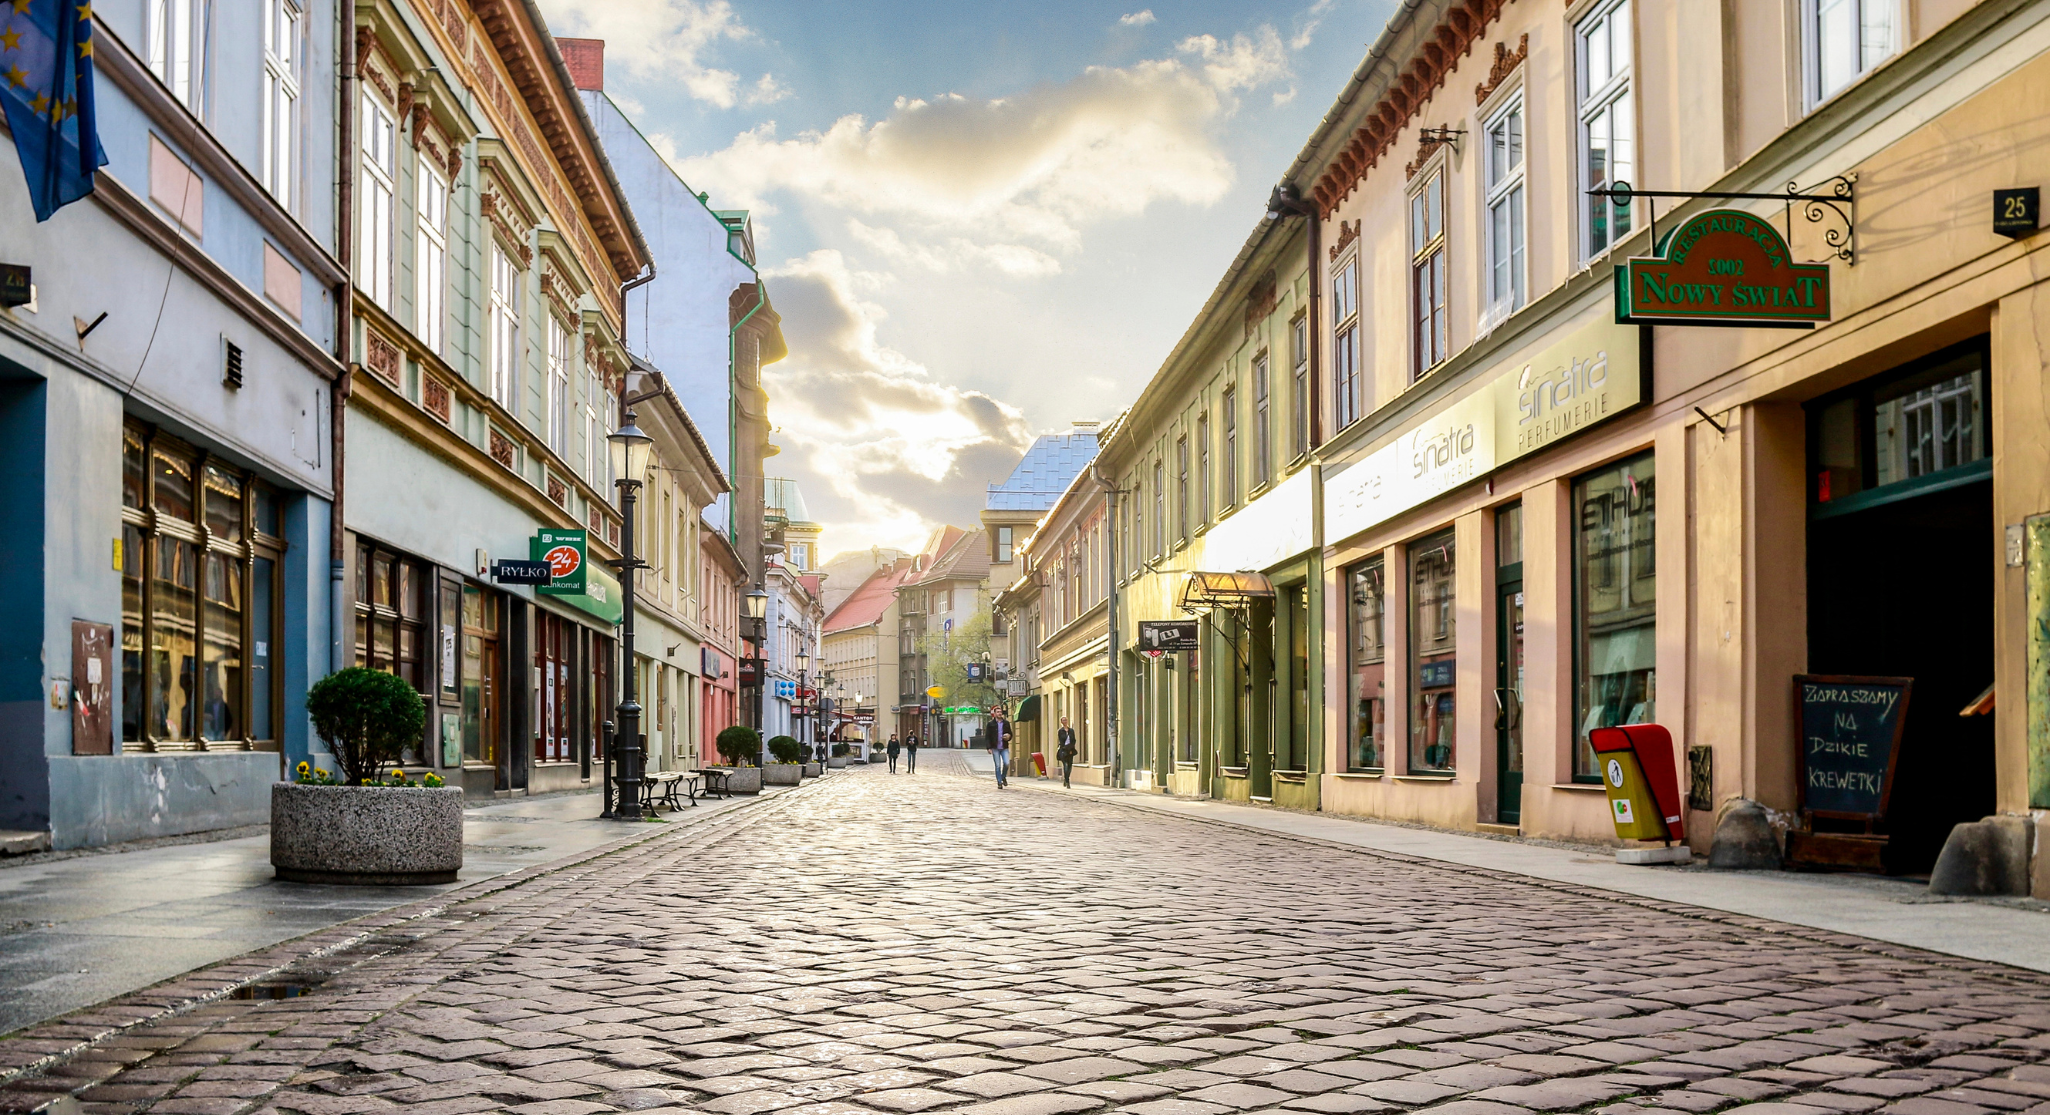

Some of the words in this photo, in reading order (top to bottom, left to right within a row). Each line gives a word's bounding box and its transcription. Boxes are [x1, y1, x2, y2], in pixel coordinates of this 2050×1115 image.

[2004, 196, 2026, 218] 25
[1673, 217, 1783, 269] RESTAURACJA
[1639, 271, 1724, 305] NOWY
[1732, 276, 1823, 308] ŚWIAT
[1518, 350, 1608, 426] sinatra
[1518, 392, 1608, 452] PERFUMERIE
[1413, 421, 1474, 480] sinatra
[501, 566, 547, 578] RYŁKO
[552, 552, 572, 569] 24
[1804, 685, 1899, 723] ZAPRASZAMY
[1835, 711, 1858, 731] NA
